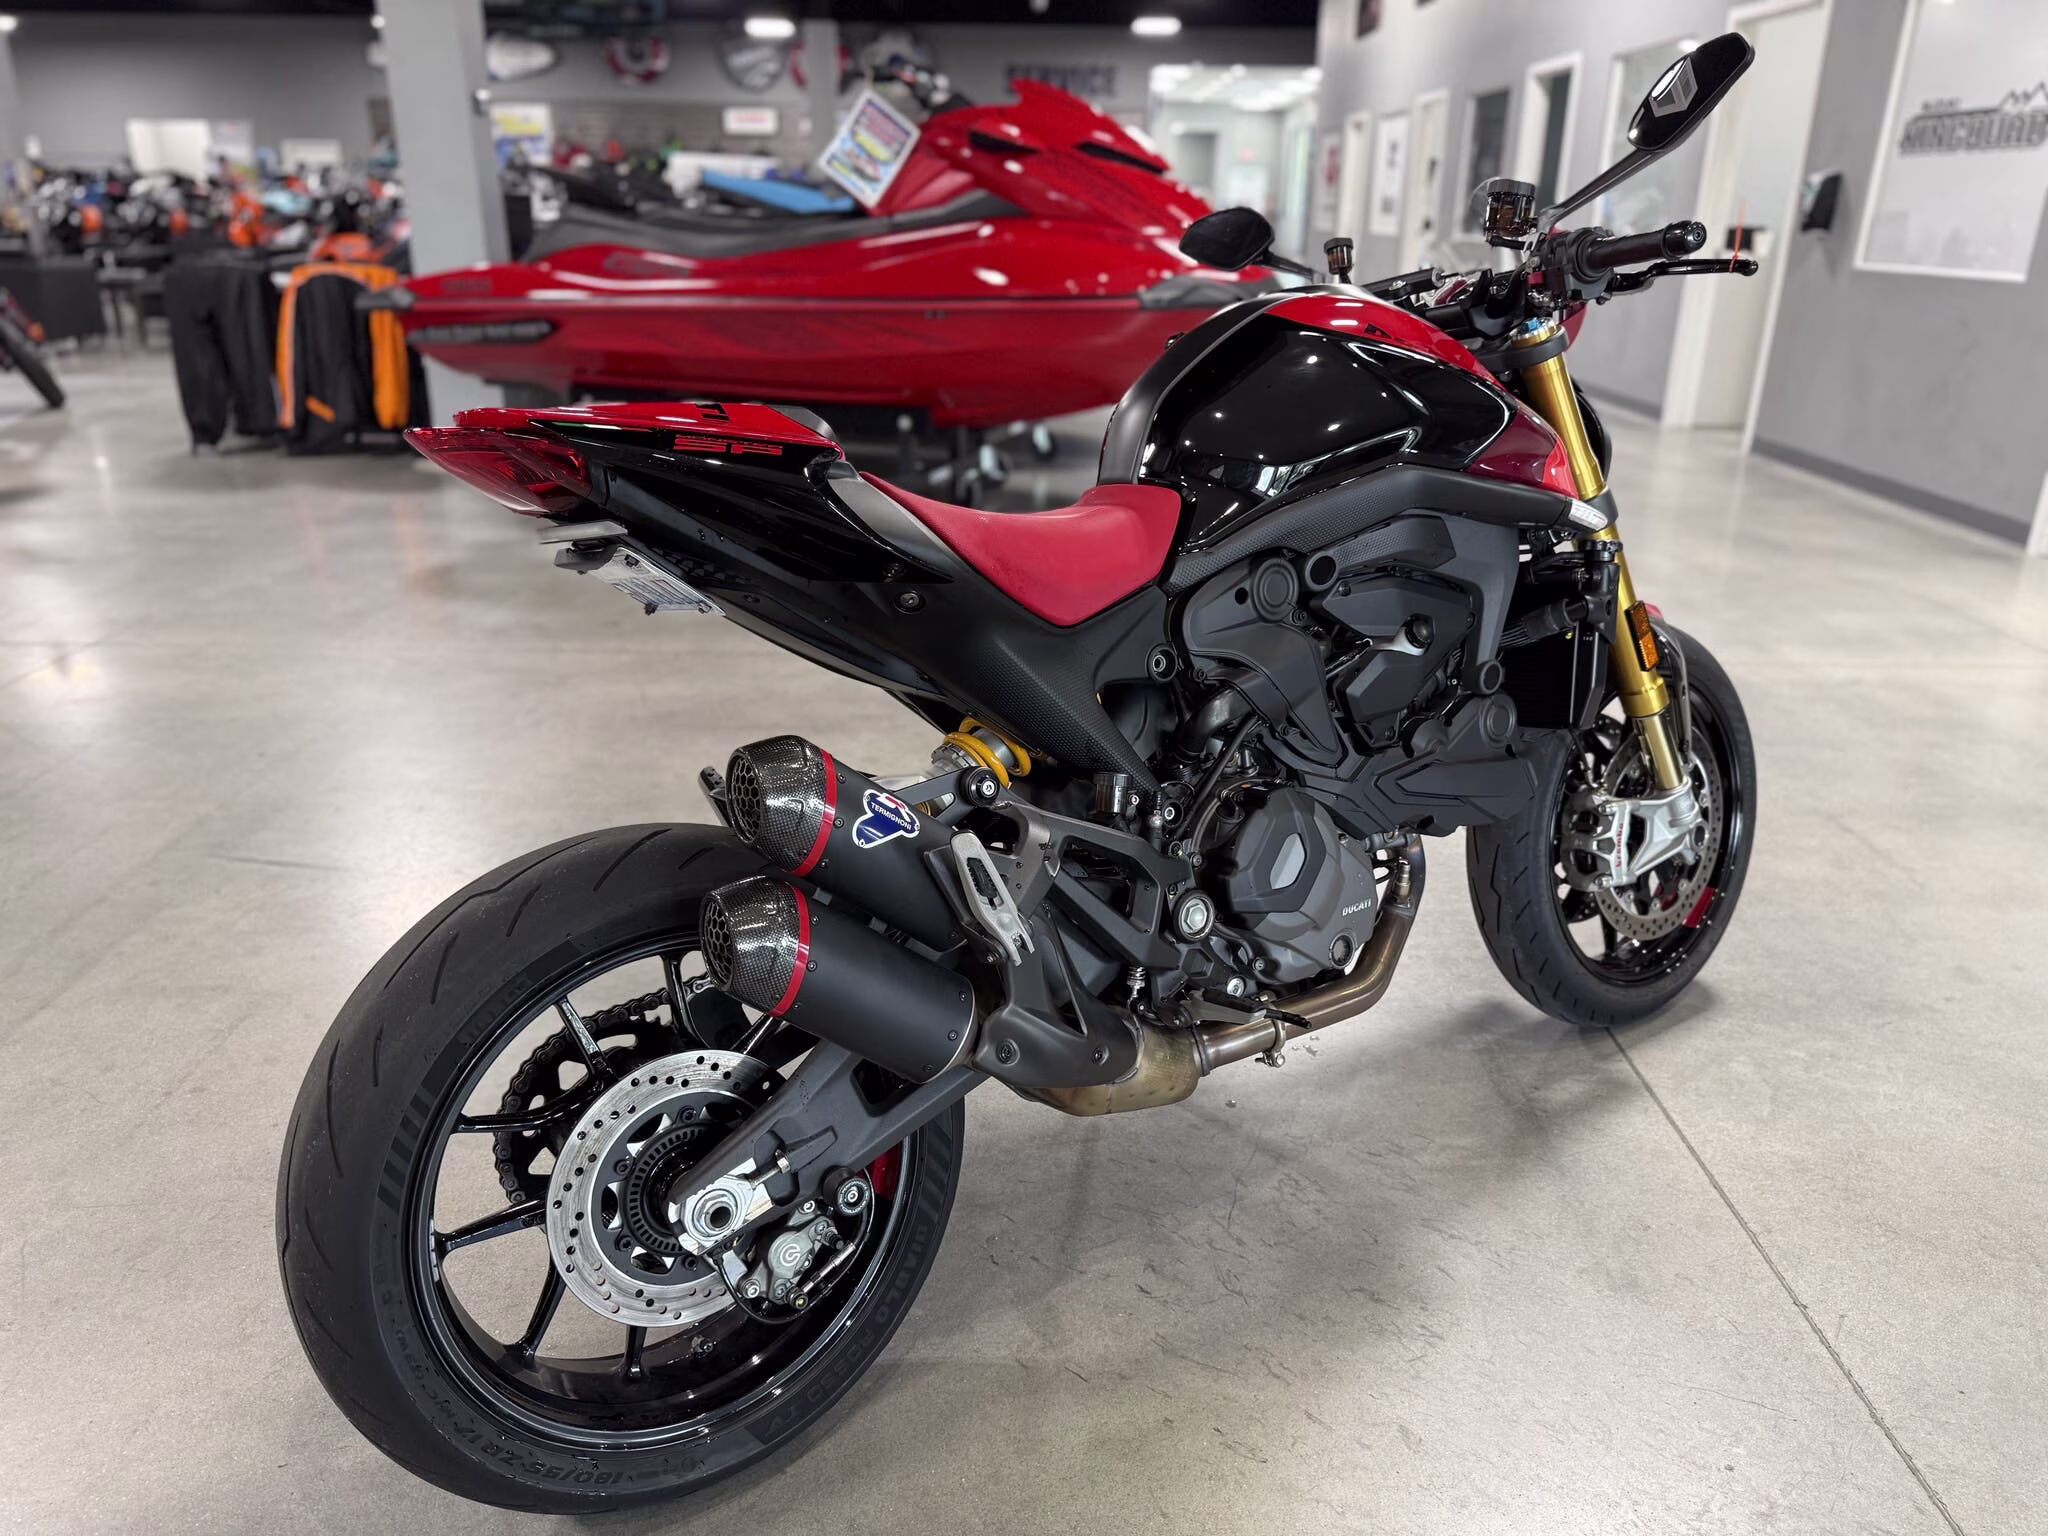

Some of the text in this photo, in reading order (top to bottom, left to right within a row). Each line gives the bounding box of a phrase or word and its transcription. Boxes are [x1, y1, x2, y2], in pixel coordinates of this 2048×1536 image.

[673, 438, 783, 456] SP
[870, 802, 912, 831] TERMIGNONI
[1616, 822, 1624, 868] brembo
[1342, 898, 1372, 917] DUCATI
[875, 1225, 928, 1325] DIABLO
[806, 1330, 877, 1401] ROSSO
[524, 1459, 623, 1485] 180/55
